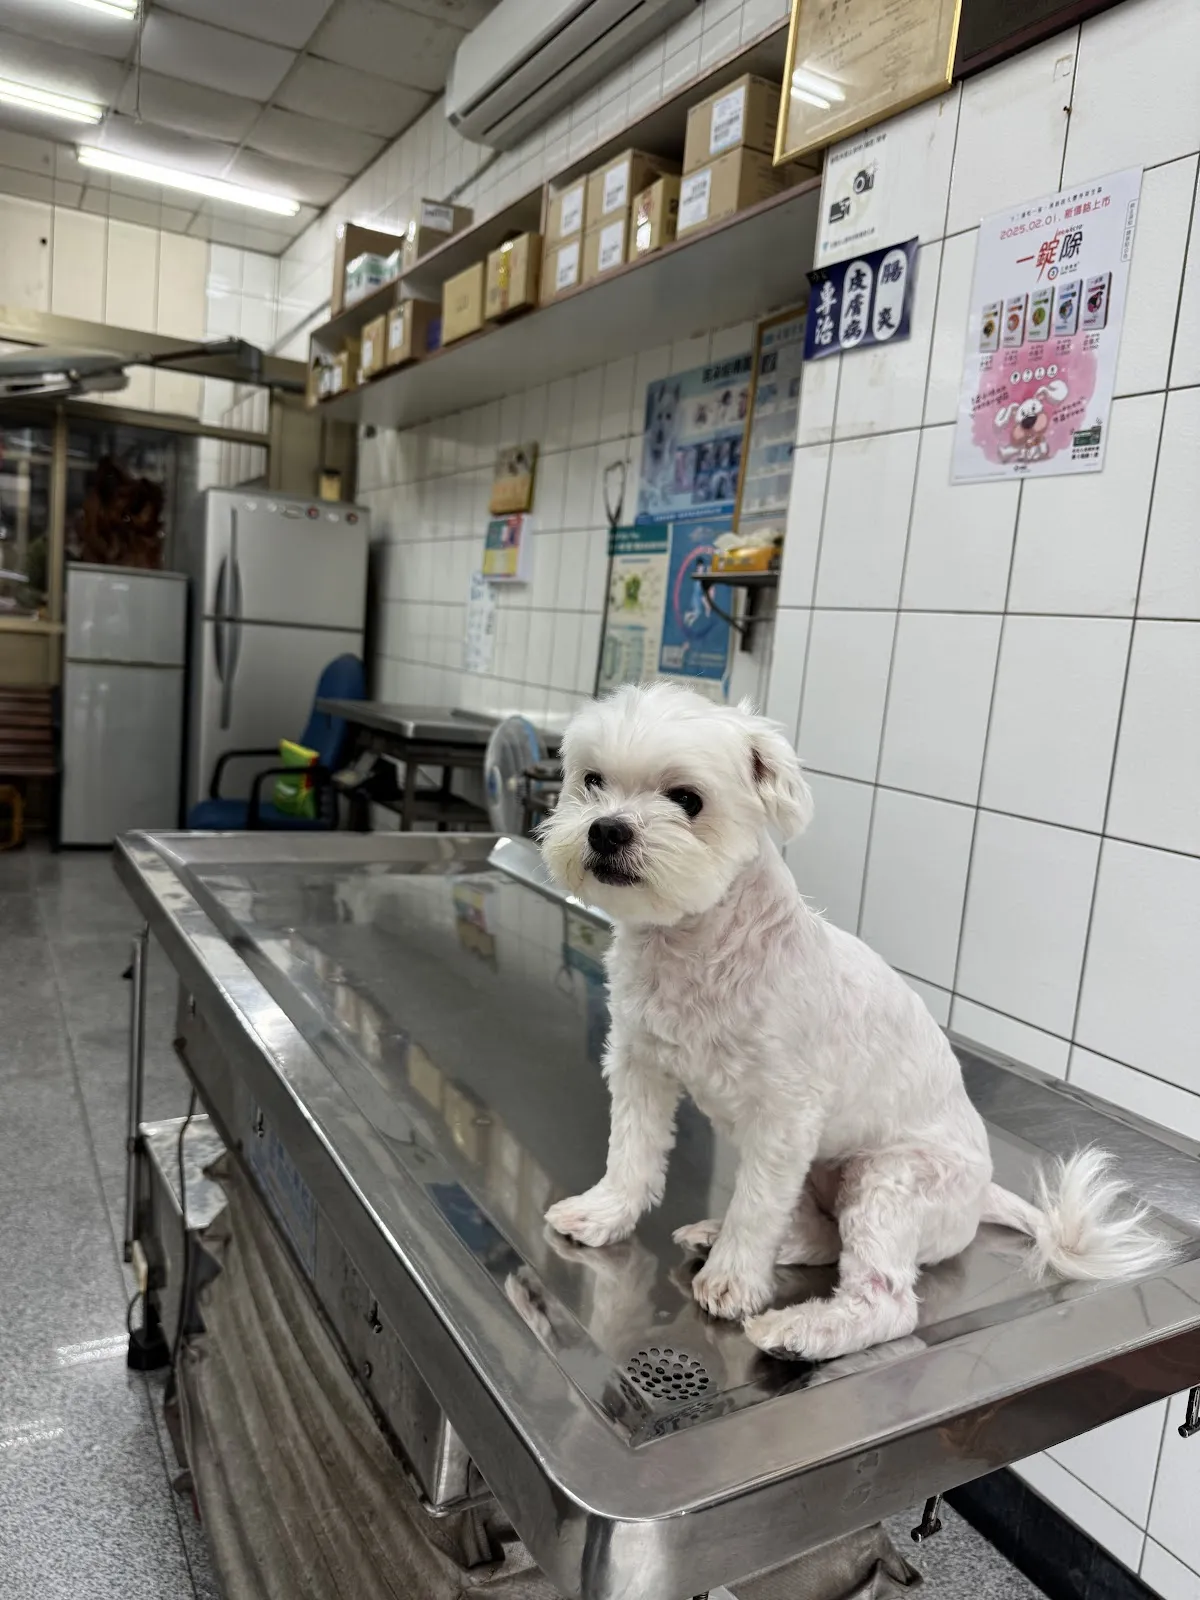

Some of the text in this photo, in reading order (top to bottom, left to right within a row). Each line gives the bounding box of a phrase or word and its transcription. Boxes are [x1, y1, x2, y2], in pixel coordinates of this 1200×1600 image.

[1016, 229, 1083, 273] 一錠除
[814, 280, 838, 345] 專治
[842, 269, 868, 343] 皮膚病
[876, 259, 904, 333] 腸炎
